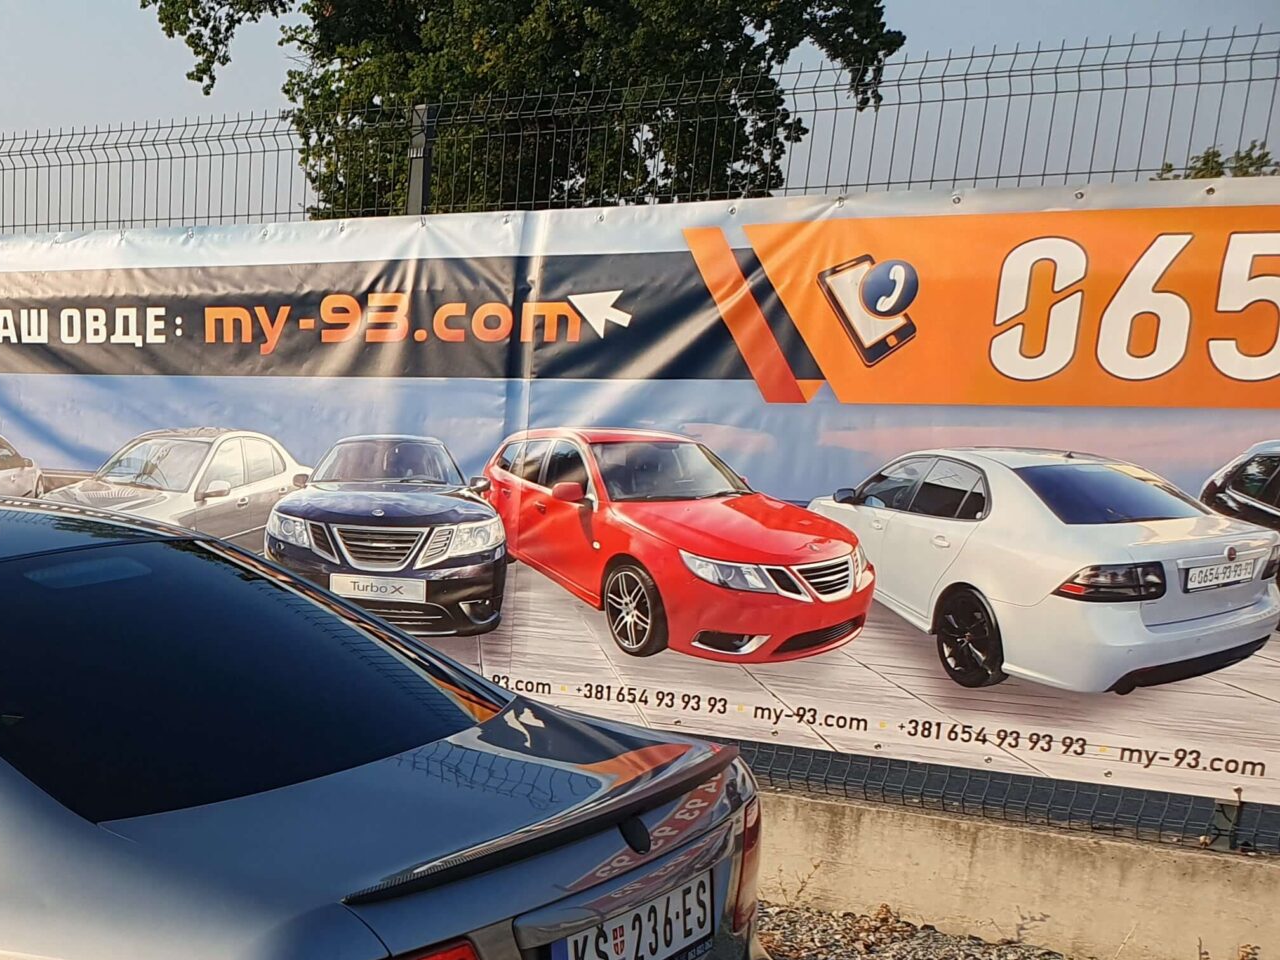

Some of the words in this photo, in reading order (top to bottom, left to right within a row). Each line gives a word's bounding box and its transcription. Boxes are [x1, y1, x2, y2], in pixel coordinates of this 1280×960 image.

[204, 291, 584, 355] my-93.com
[351, 581, 388, 594] Turbo
[391, 586, 404, 595] X
[492, 674, 551, 695] 93.com
[616, 686, 648, 706] 654
[656, 690, 675, 708] 93
[681, 693, 701, 711] 93
[707, 697, 728, 715] 93
[753, 703, 868, 732] my-93.com
[947, 723, 988, 745] 654
[996, 729, 1020, 749] 93
[1028, 733, 1053, 753] 93
[1061, 736, 1087, 757] 93
[1120, 745, 1266, 777] my-93.com
